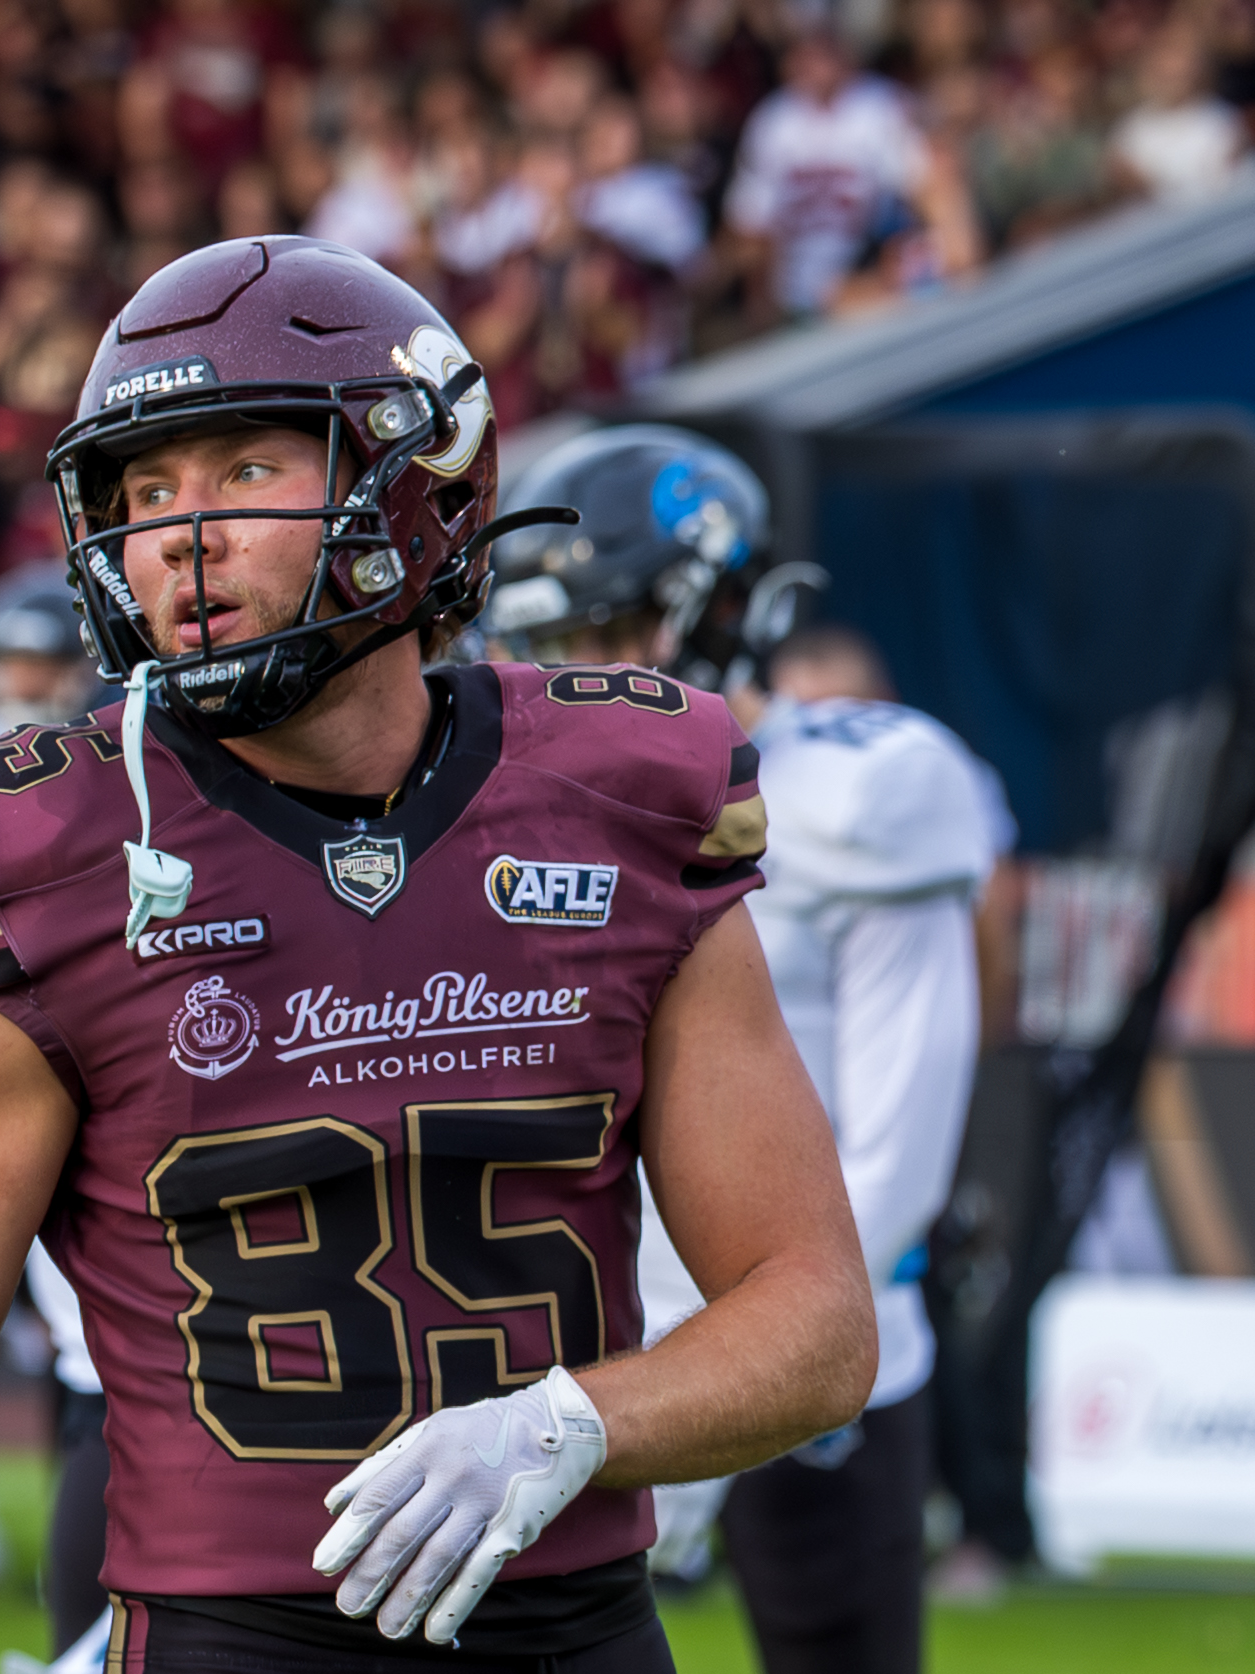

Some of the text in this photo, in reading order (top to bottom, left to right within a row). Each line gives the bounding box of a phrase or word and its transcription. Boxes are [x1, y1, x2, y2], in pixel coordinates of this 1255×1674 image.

[105, 364, 204, 406] FORELLE
[180, 662, 244, 688] Riddell
[534, 662, 690, 717] 8
[509, 867, 612, 911] AFLE
[274, 971, 589, 1047] König Pilsener
[307, 1043, 556, 1088] ALKOHOLFREI
[142, 1090, 618, 1463] 85
